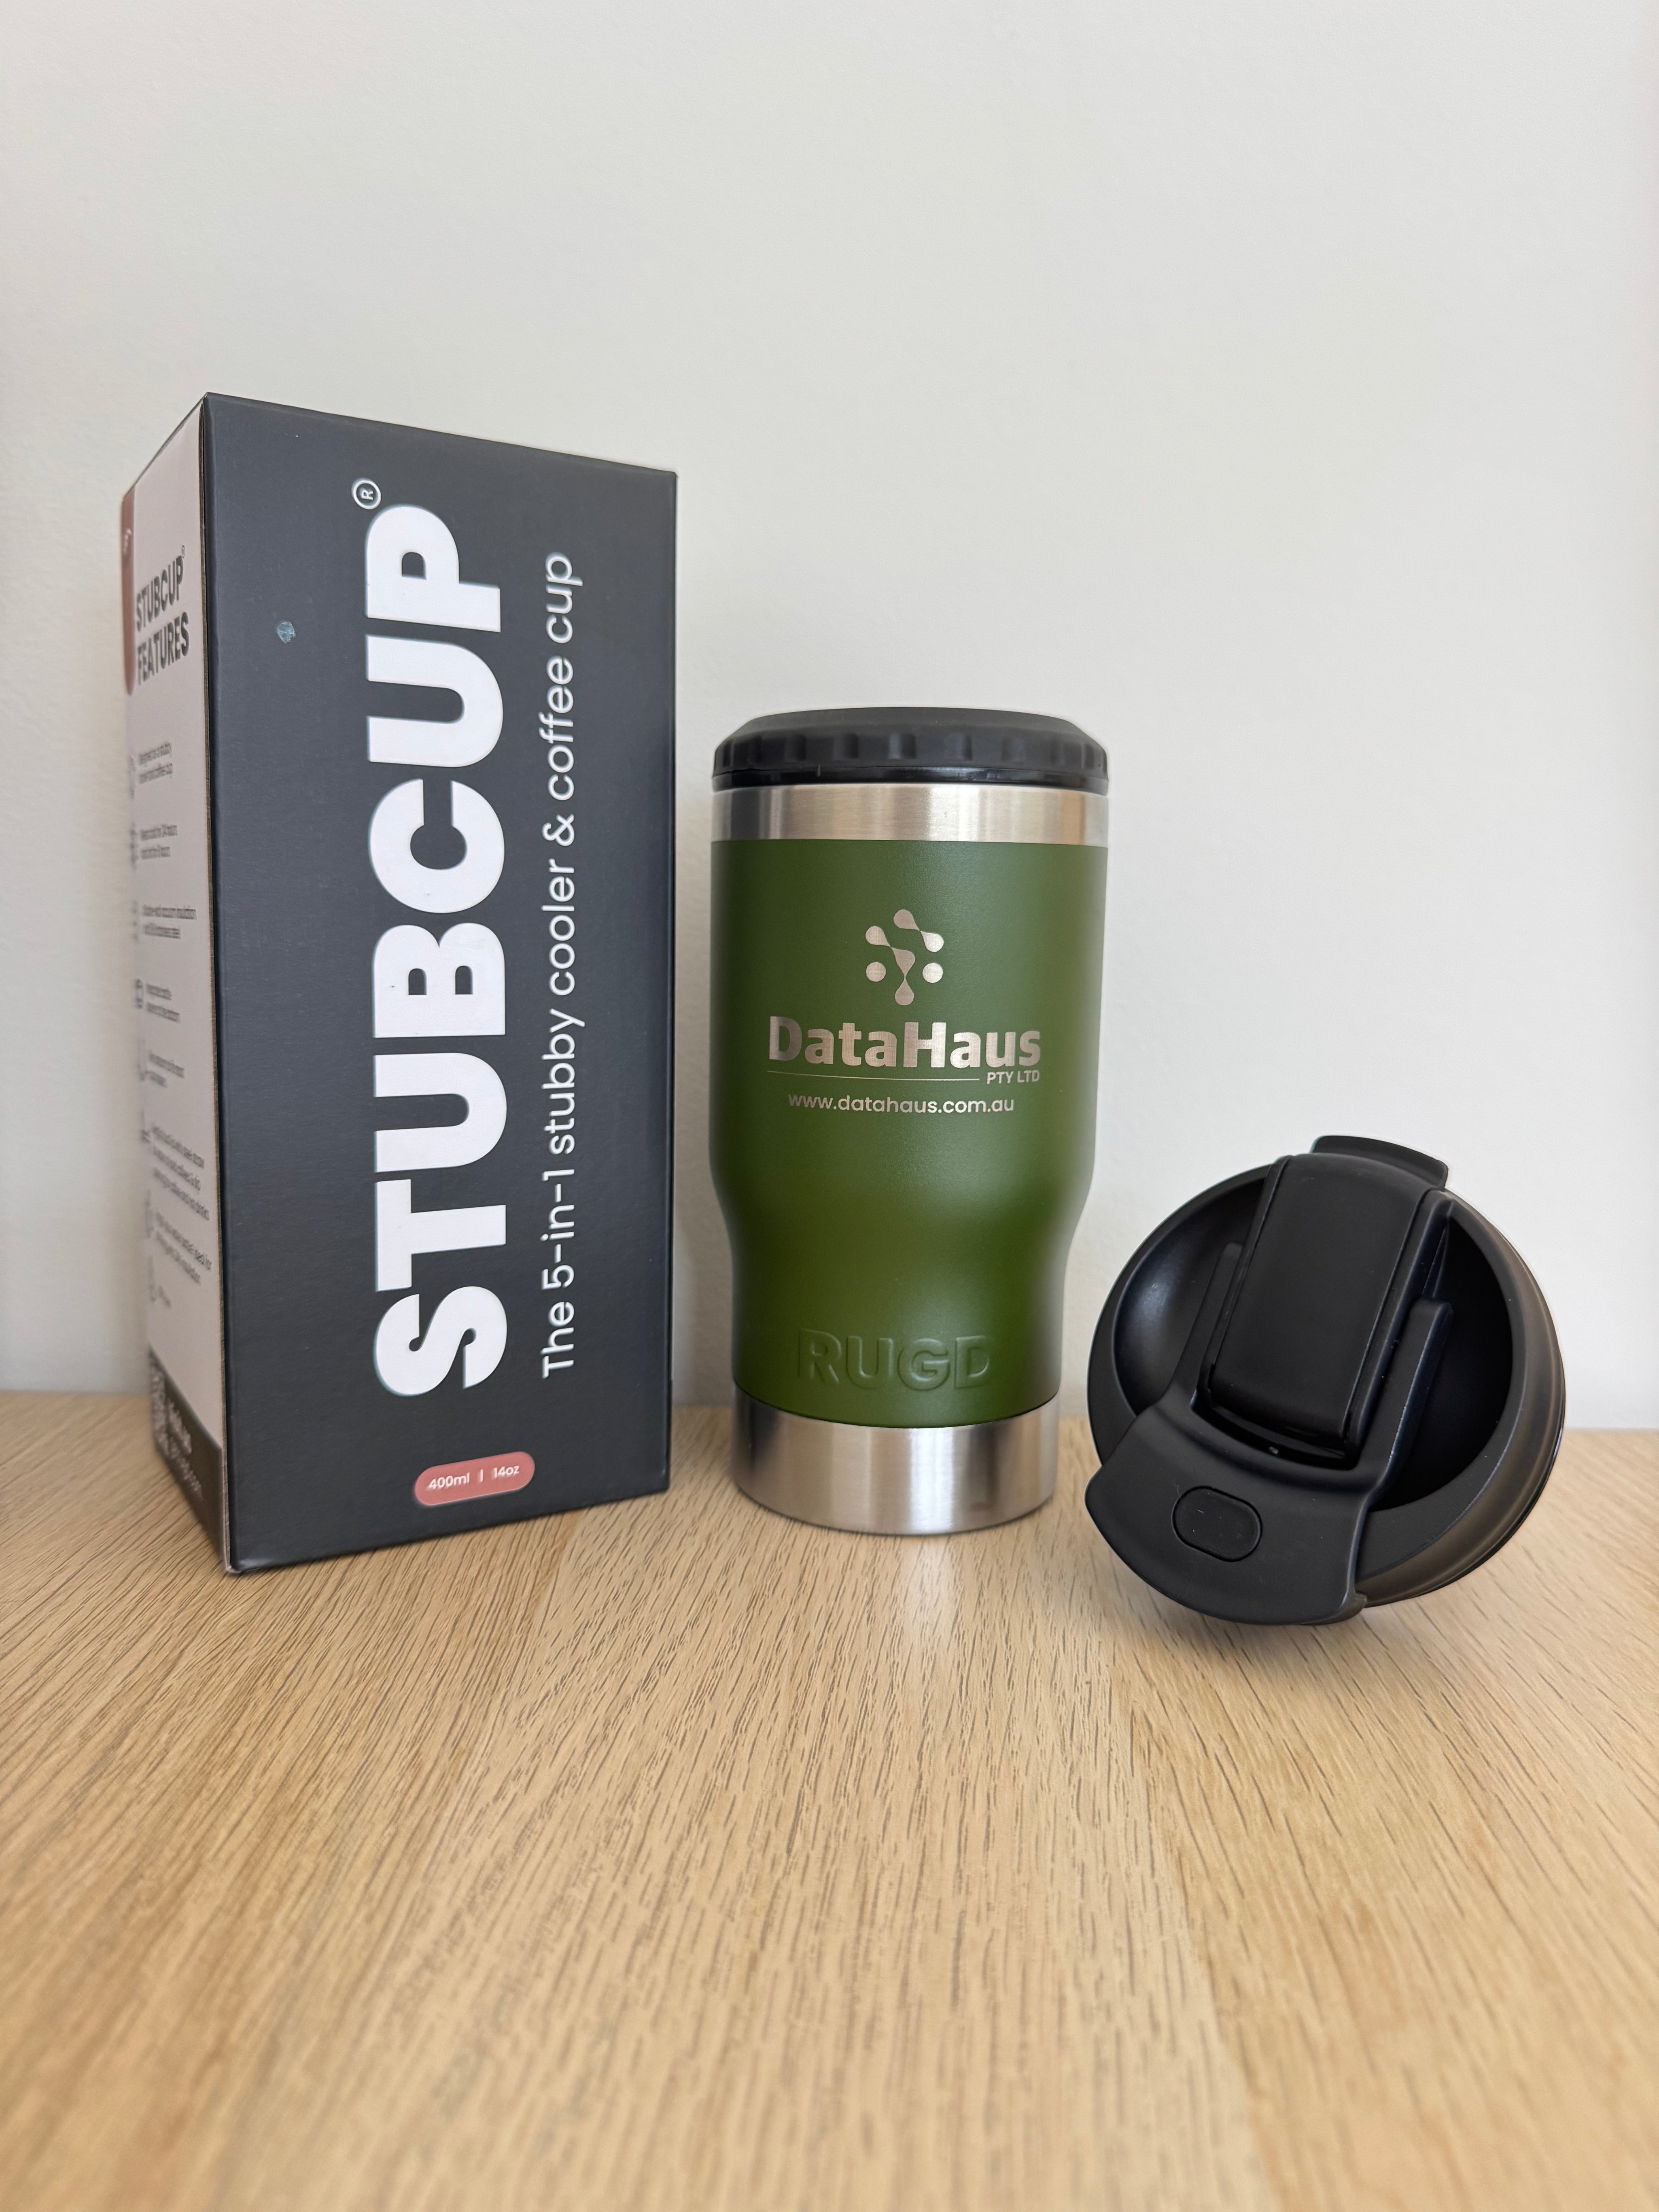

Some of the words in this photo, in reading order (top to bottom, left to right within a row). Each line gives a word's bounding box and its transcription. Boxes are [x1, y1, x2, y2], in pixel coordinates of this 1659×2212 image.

[545, 553, 583, 644] cup
[137, 611, 189, 686] FEATURES
[539, 656, 574, 801] coffee
[542, 814, 575, 846] &
[541, 858, 575, 996] cooler
[769, 1016, 1041, 1068] DataHaus
[986, 1071, 1014, 1084] PTY
[1017, 1070, 1040, 1083] LTD
[541, 1008, 585, 1155] stubby
[788, 1093, 1014, 1113] www.datahaus.com.au
[541, 1169, 575, 1291] 5-in-1
[541, 1301, 575, 1379] The
[799, 1328, 997, 1391] RUGD
[427, 1472, 470, 1490] 400ml
[492, 1465, 519, 1478] 14oz
